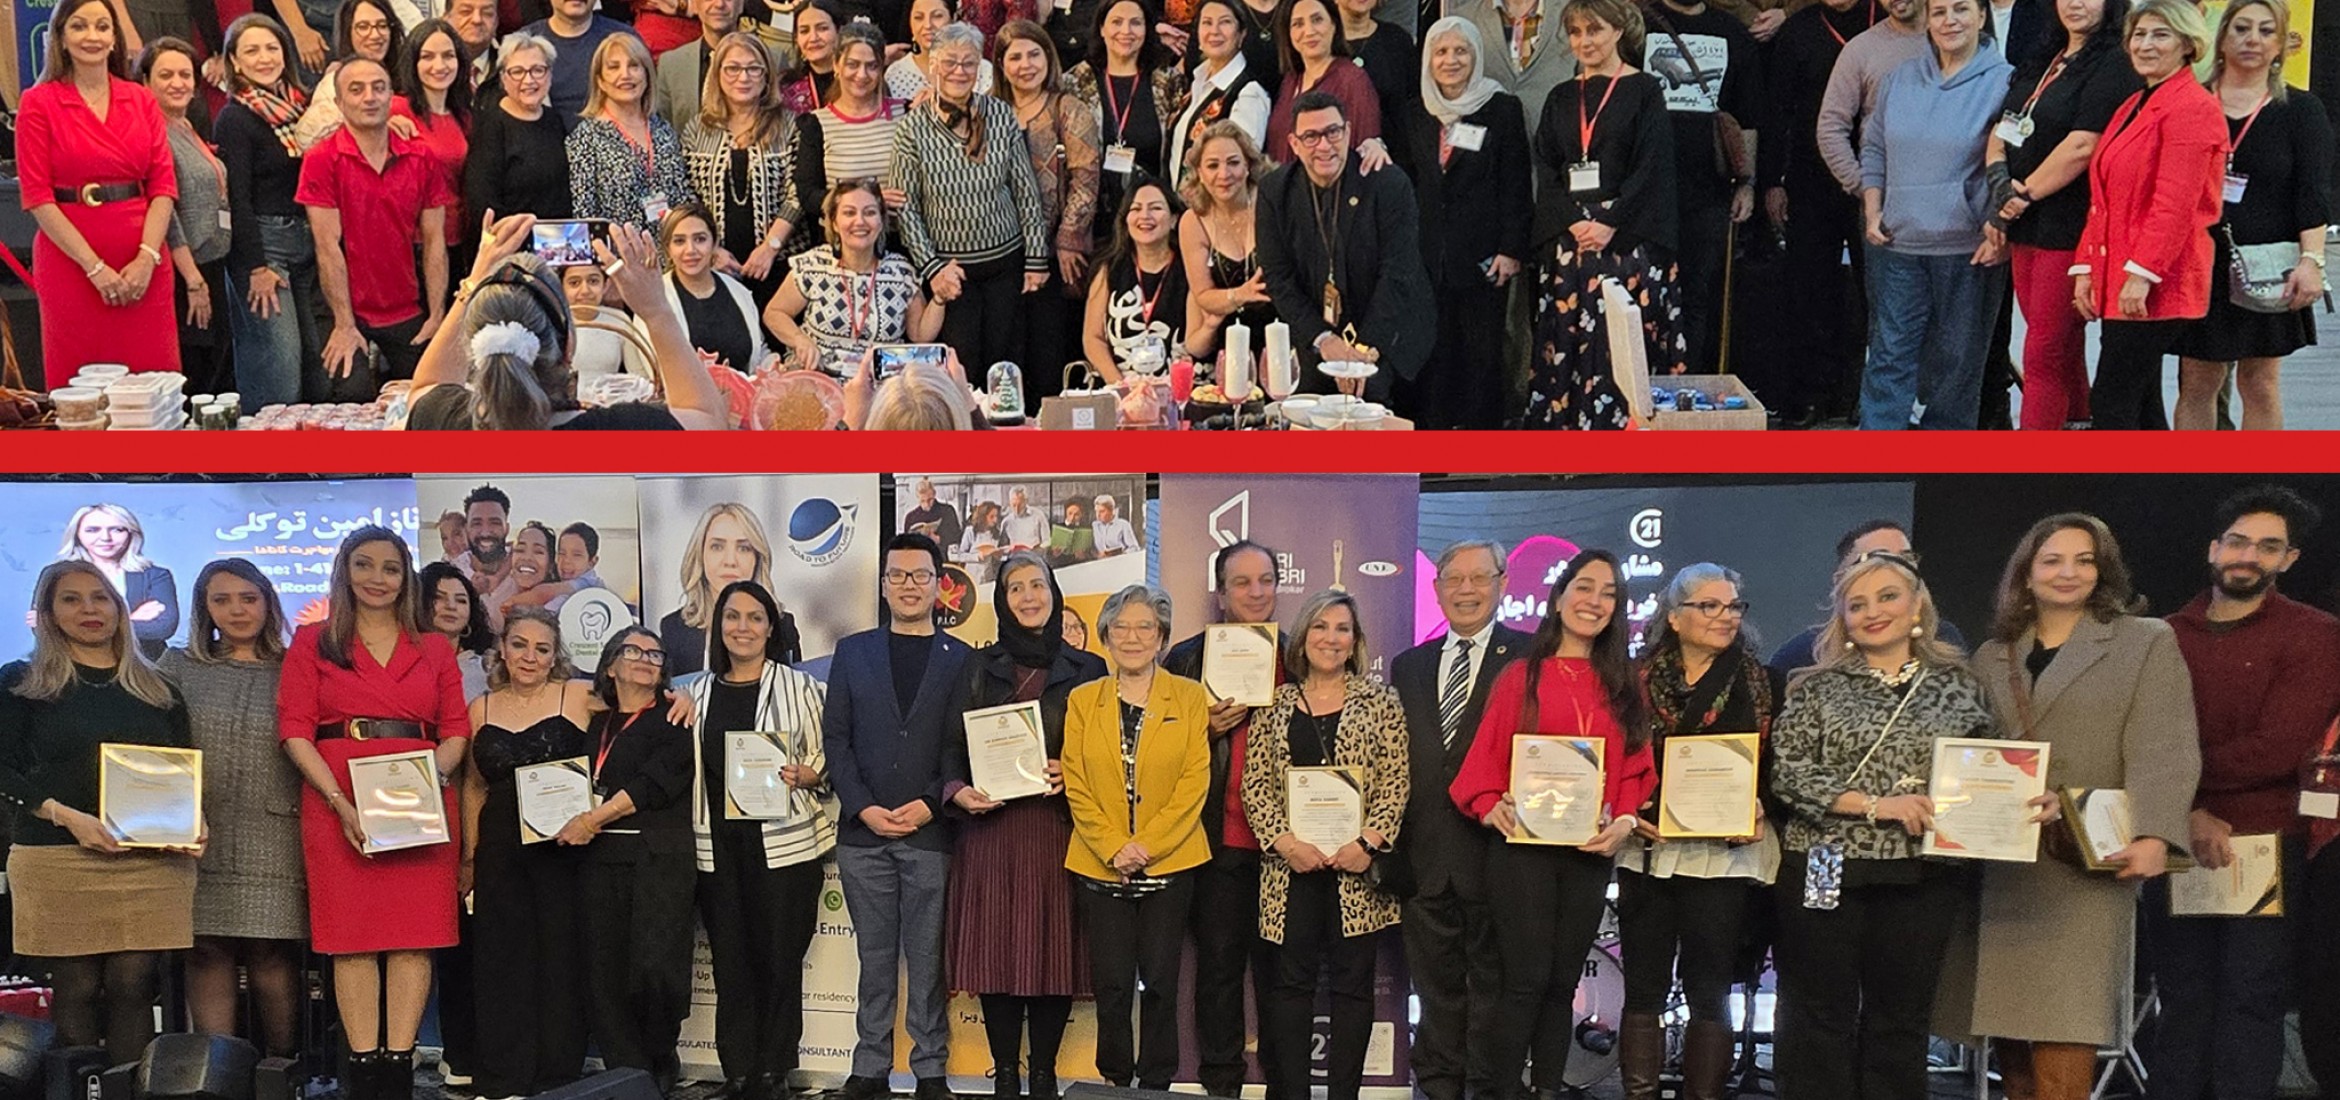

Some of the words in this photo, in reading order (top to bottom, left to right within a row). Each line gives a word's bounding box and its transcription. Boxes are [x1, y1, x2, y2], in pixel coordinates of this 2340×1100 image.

[216, 511, 306, 540] توکلی
[820, 922, 854, 939] Entry
[813, 991, 857, 1004] residency
